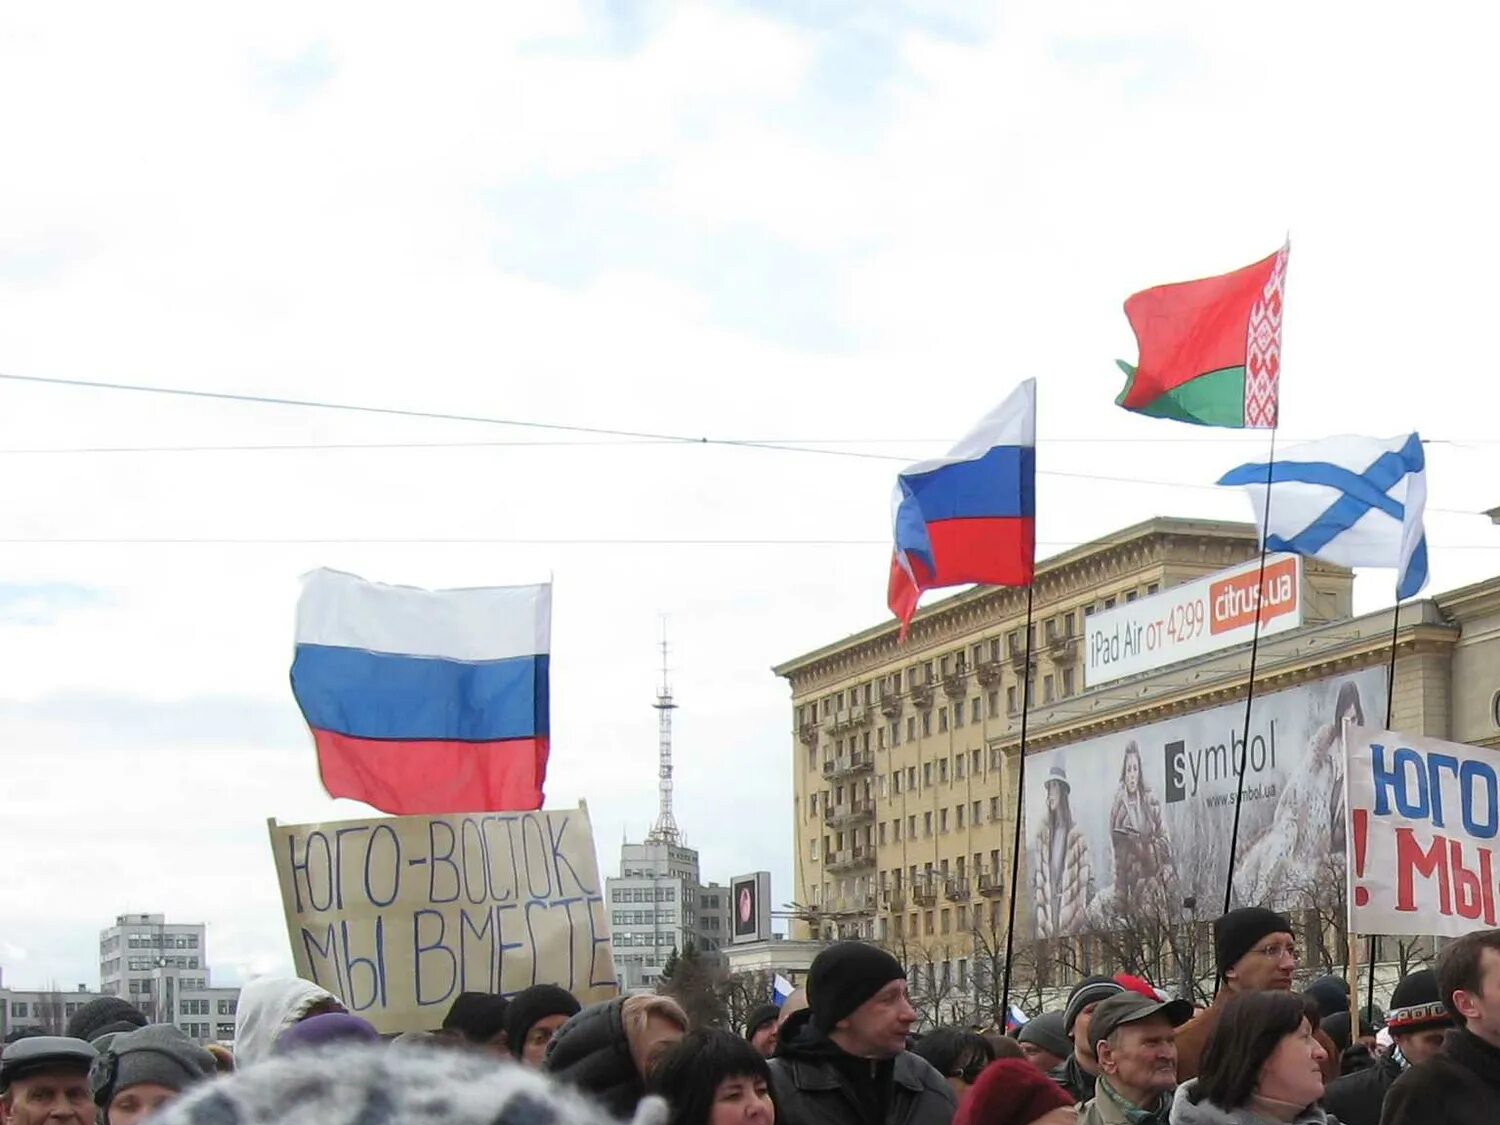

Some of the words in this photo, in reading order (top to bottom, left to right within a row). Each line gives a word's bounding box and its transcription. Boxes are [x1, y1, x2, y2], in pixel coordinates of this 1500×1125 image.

[1091, 622, 1119, 668] iPad
[1124, 622, 1143, 660] Air
[1167, 599, 1204, 646] 4299
[1215, 573, 1292, 622] citrus.ua
[1172, 720, 1275, 797] symbol
[1206, 783, 1277, 808] www.smbol.ua
[289, 814, 596, 913] ЮГО-ВОСТОК
[301, 914, 388, 1011] МЫ
[414, 896, 618, 1006] ВМЕСТЕ
